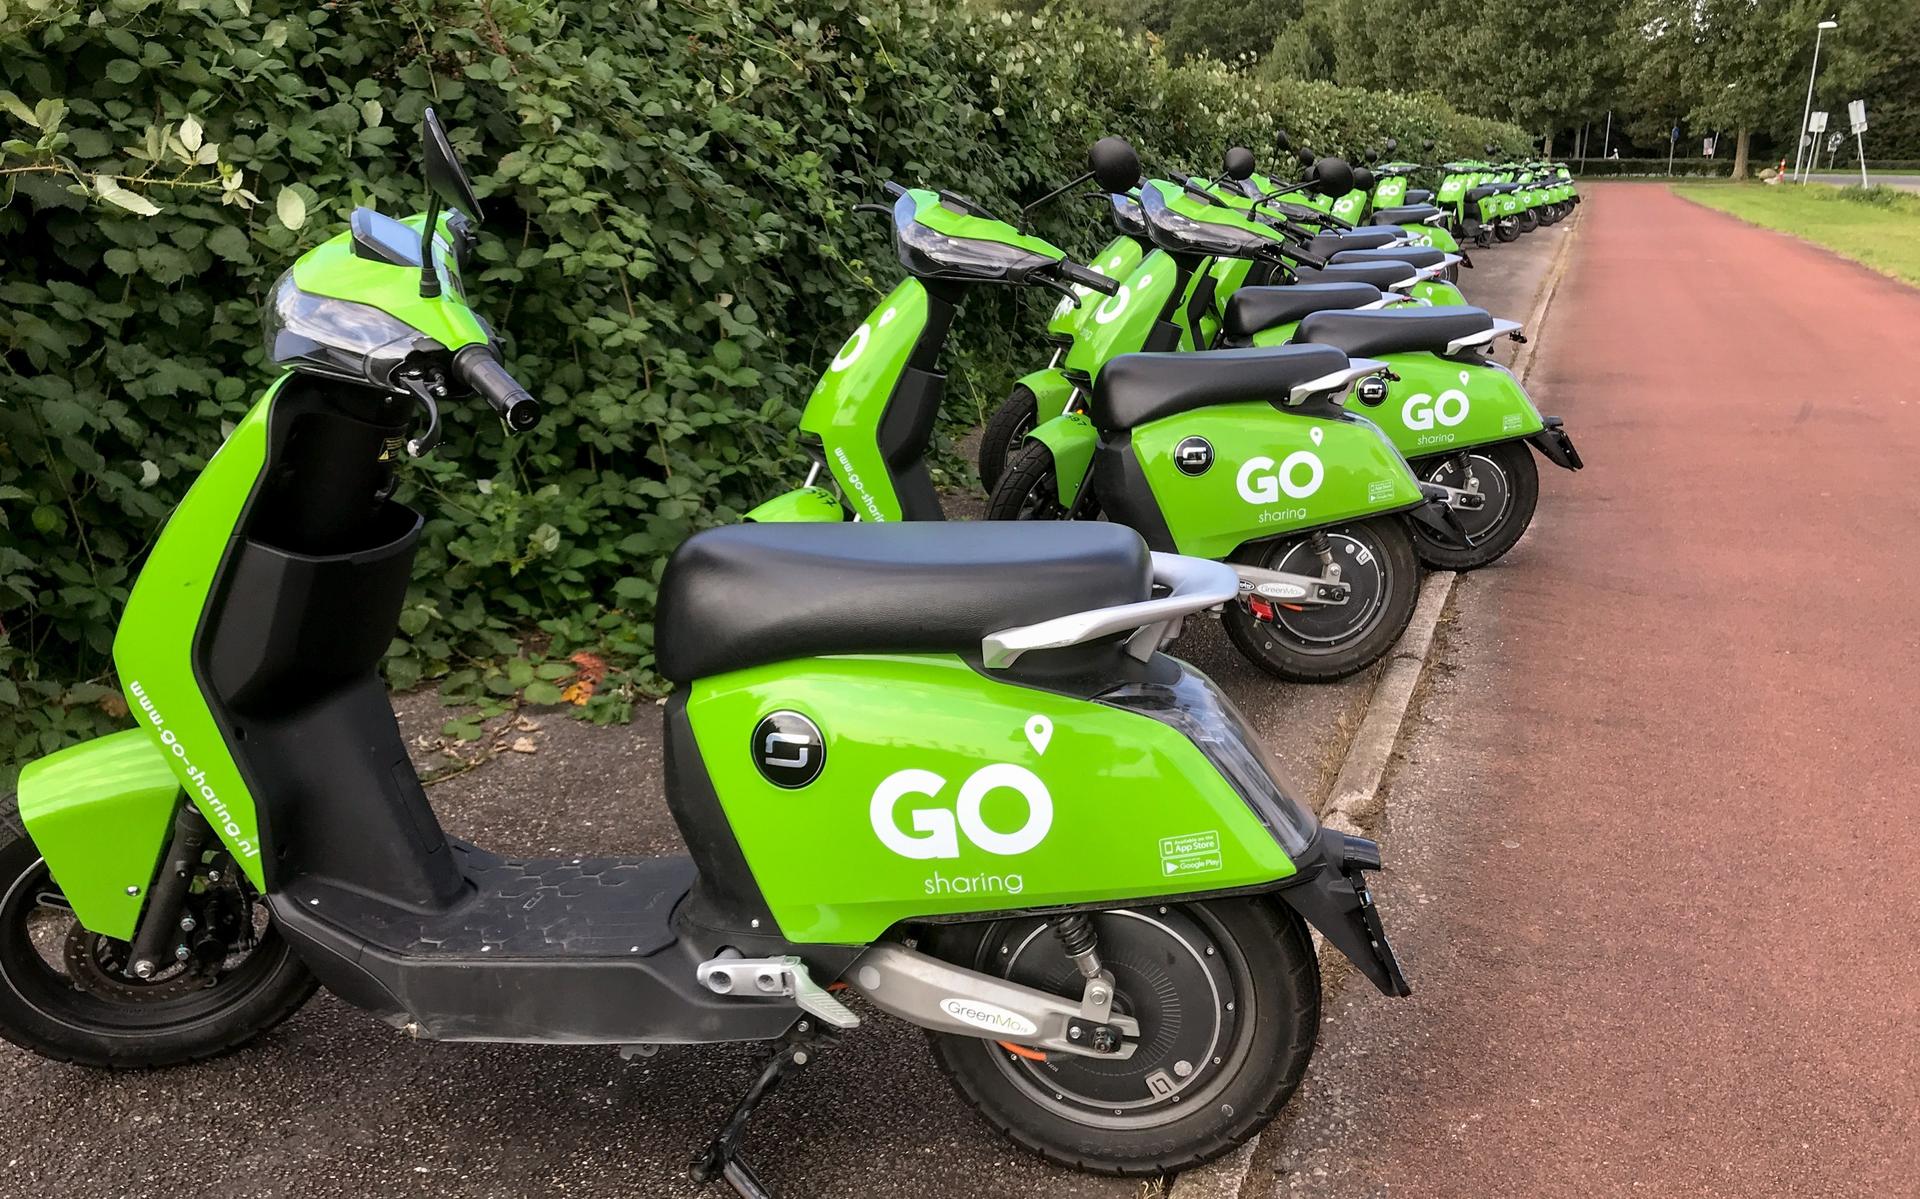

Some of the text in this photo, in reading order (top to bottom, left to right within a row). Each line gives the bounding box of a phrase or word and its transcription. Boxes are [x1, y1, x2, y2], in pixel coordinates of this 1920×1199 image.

[1377, 184, 1400, 196] GO
[1503, 201, 1516, 211] GO
[1401, 389, 1470, 431] GO
[1417, 433, 1455, 446] sharing
[1236, 450, 1325, 505] GO
[1258, 508, 1307, 523] sharing
[129, 679, 261, 859] www.go-sharing.nl
[869, 763, 1054, 860] GO
[1175, 840, 1215, 853] App Store
[1180, 860, 1205, 870] Google
[1205, 859, 1220, 868] Play
[924, 870, 1024, 895] sharing
